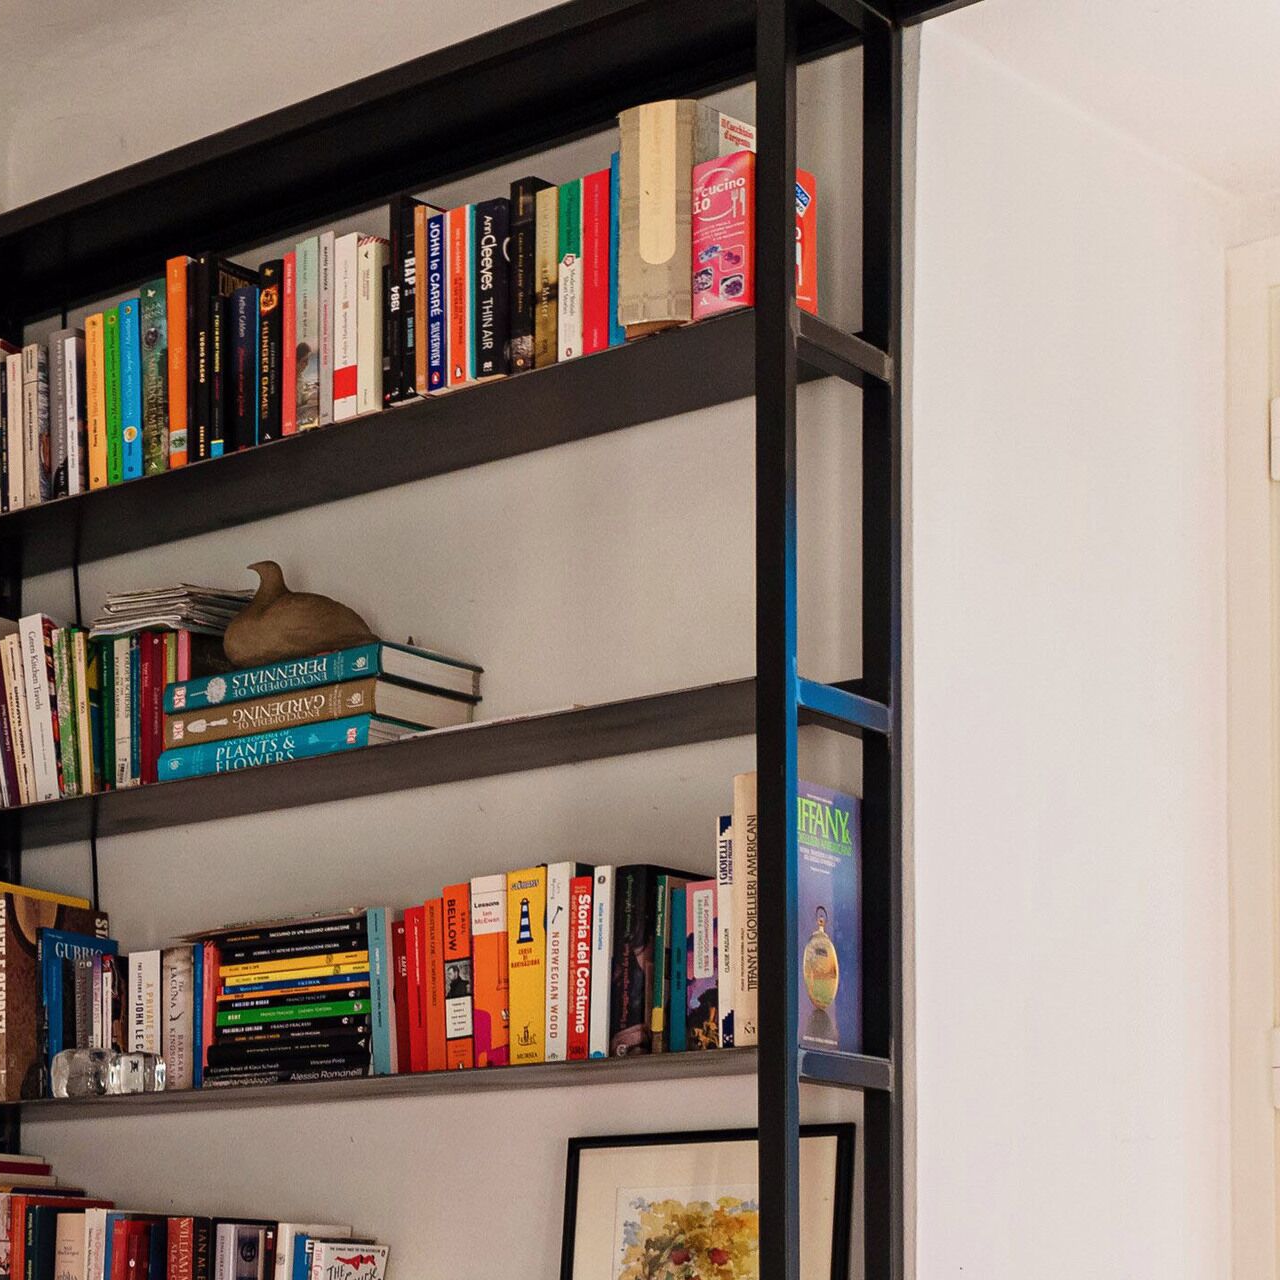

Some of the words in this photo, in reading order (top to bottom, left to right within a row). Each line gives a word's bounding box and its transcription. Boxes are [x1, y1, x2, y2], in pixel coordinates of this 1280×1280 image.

[701, 177, 745, 198] cucino
[693, 197, 711, 215] io
[430, 222, 440, 256] JOHN
[483, 216, 493, 235] Ann
[404, 257, 415, 285] RAP
[430, 259, 440, 269] le
[481, 234, 496, 290] Cleeves
[238, 296, 247, 314] Arthur
[391, 286, 400, 312] 1984
[430, 272, 443, 317] CARRÉ
[482, 297, 493, 328] THIN
[238, 315, 247, 338] Golden
[482, 330, 493, 349] AIR
[261, 321, 269, 374] HUNGER
[430, 321, 441, 366] SILVERVIEW
[261, 376, 269, 419] GAMES
[27, 630, 39, 654] Green
[30, 655, 42, 684] Kitchen
[232, 657, 327, 688] PERENNIALS
[172, 686, 186, 708] DK
[232, 686, 249, 698] OF
[259, 672, 328, 695] ENCYCLOPEDIA
[32, 686, 43, 710] Travels
[232, 693, 325, 723] GARDENING
[171, 720, 185, 741] DK
[235, 718, 254, 730] OF
[255, 706, 320, 729] ENCYCLOPEDIA
[215, 740, 275, 762] PLANTS
[276, 735, 295, 751] &
[746, 814, 757, 877] AMERICANI
[720, 840, 728, 880] GIOIELLI
[474, 901, 500, 909] Lessons
[577, 894, 591, 939] Storia
[747, 880, 757, 939] GIOIELLIERI
[447, 899, 457, 951] BELLOW
[550, 931, 560, 1000] NORWEGIAN
[577, 942, 589, 964] del
[747, 953, 758, 991] TIFFANY
[170, 967, 178, 1008] LACUNA
[576, 967, 589, 1033] Costume
[135, 1002, 144, 1025] JOHN
[146, 992, 154, 1028] PRIVATE
[549, 1004, 559, 1039] WOOD
[135, 1029, 144, 1039] LE
[168, 1028, 177, 1088] KINGSOLVER
[290, 1071, 319, 1081] Alessio
[320, 1068, 363, 1078] Romanelli
[178, 1218, 190, 1273] WILLIAM
[198, 1229, 207, 1253] IAN
[326, 1263, 346, 1280] THE
